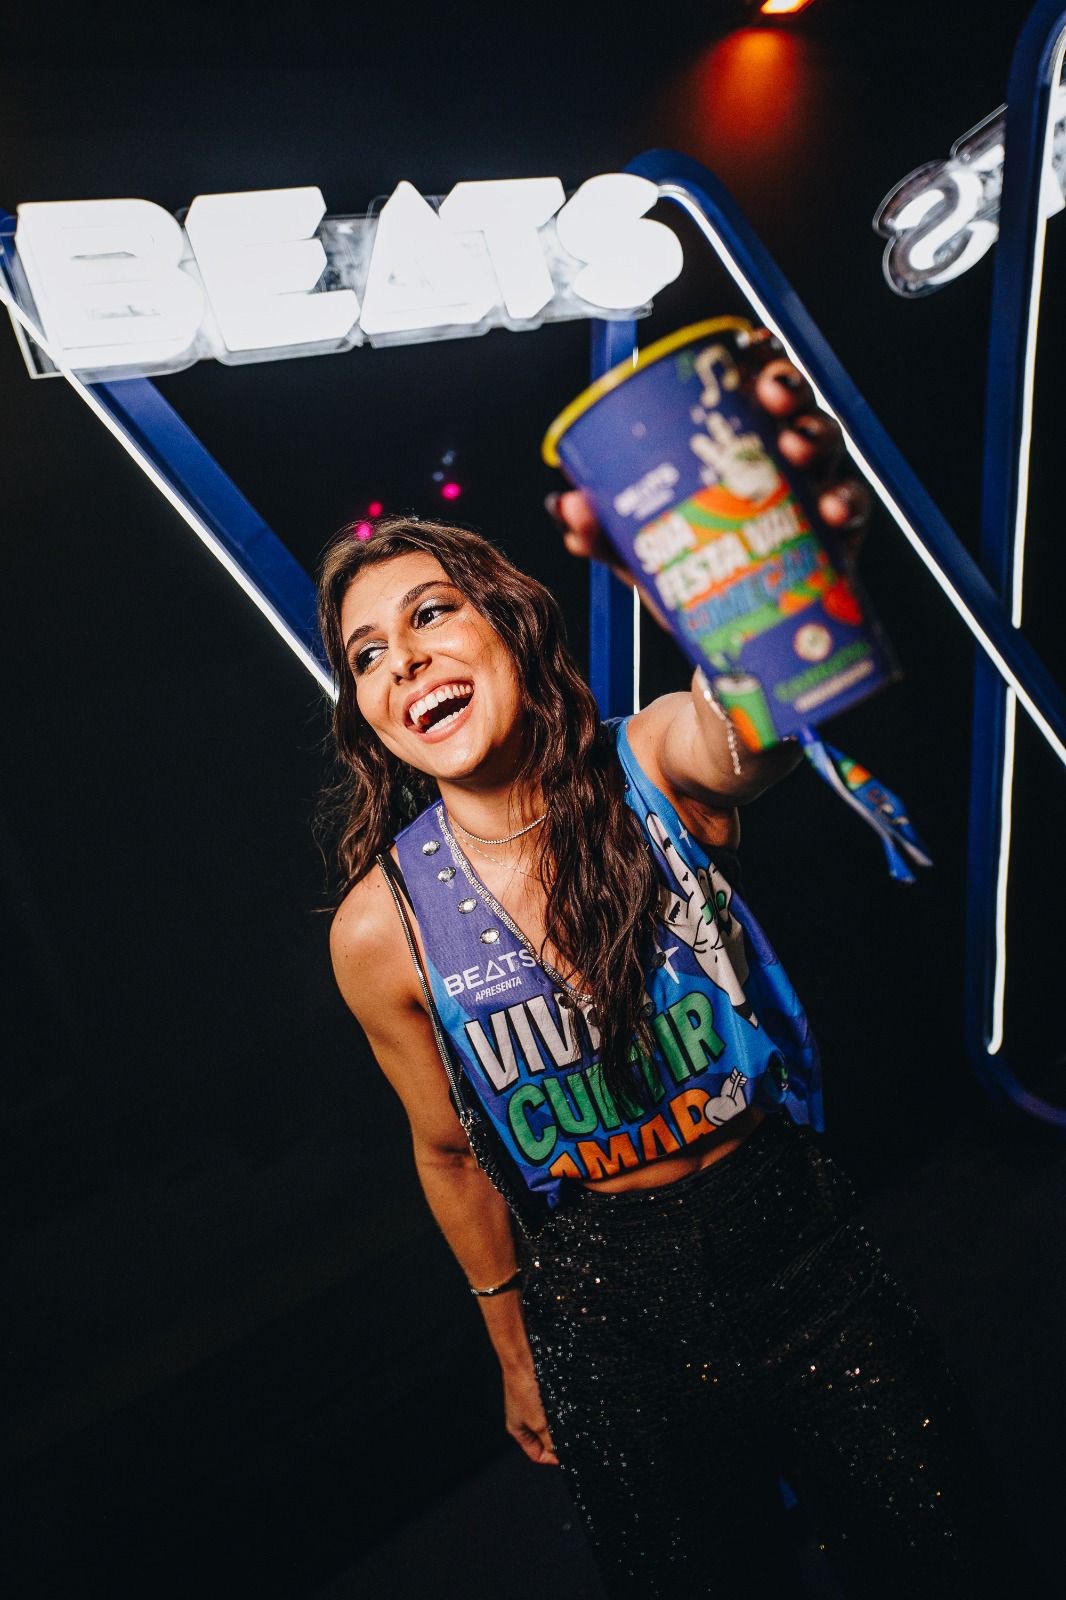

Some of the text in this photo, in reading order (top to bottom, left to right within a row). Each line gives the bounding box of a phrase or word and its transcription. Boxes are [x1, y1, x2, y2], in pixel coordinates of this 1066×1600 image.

[15, 173, 684, 372] BEATS
[443, 949, 537, 997] BEATS
[475, 976, 522, 1002] APRESENTA
[464, 992, 652, 1092] VIV
